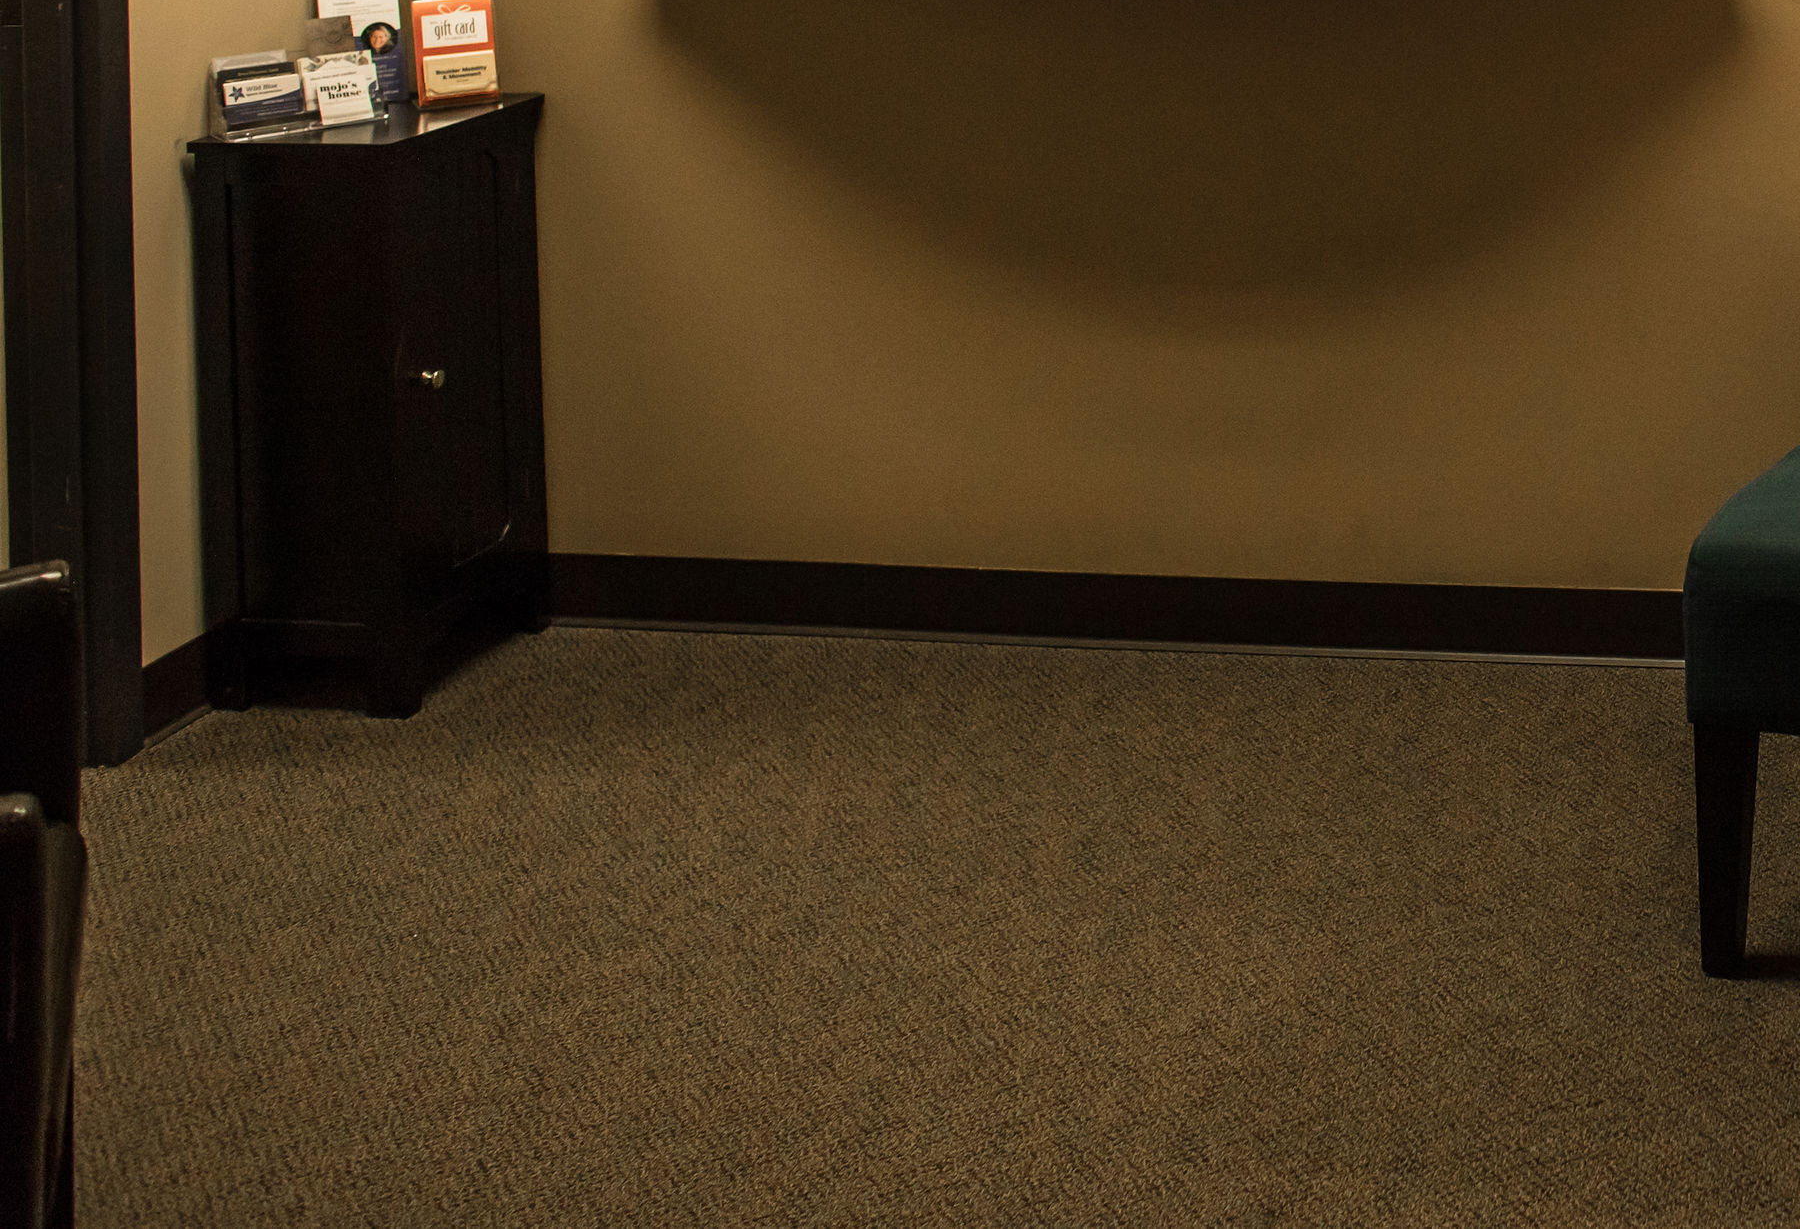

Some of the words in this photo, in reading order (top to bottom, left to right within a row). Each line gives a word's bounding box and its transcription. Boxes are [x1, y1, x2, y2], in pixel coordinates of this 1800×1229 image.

[434, 18, 452, 41] gift
[455, 16, 476, 35] card
[462, 65, 487, 73] Mobility
[449, 71, 481, 79] Movement
[246, 83, 262, 92] Wild
[263, 82, 279, 91] Blue
[319, 81, 357, 93] mojo's
[328, 90, 362, 100] house
